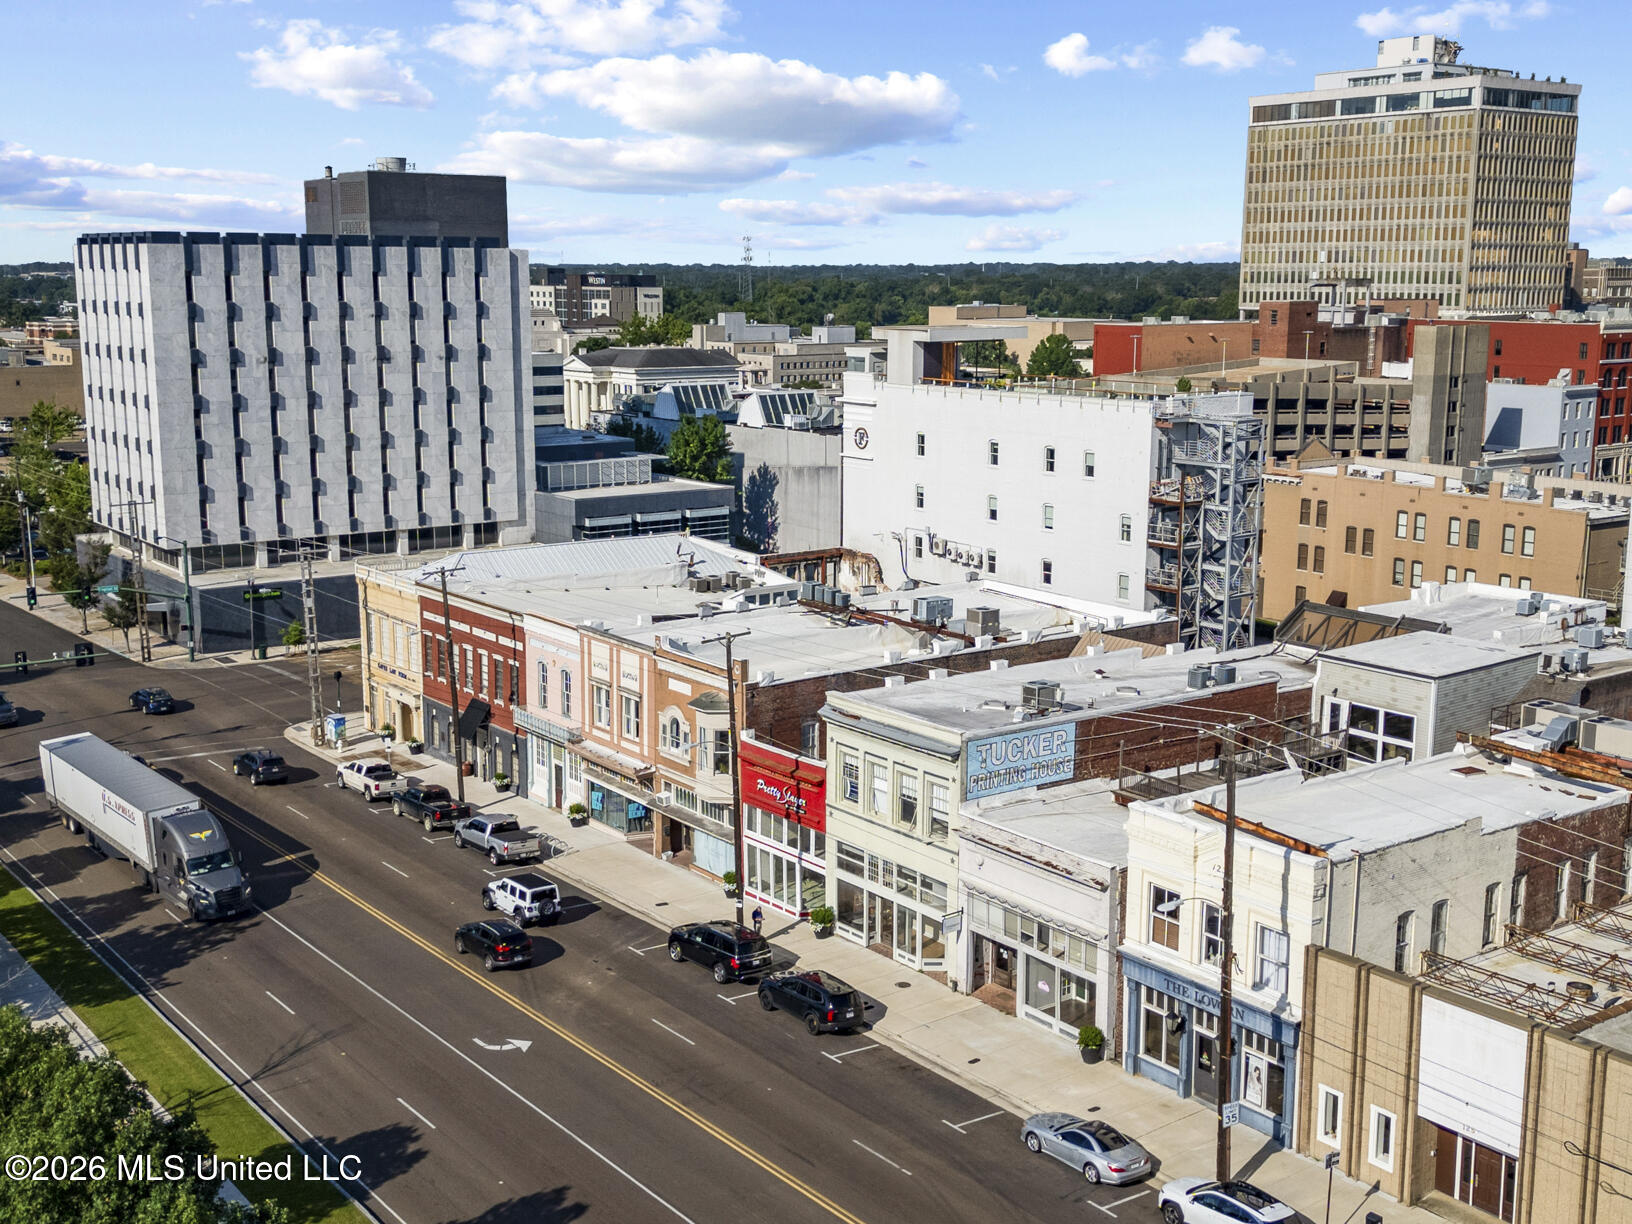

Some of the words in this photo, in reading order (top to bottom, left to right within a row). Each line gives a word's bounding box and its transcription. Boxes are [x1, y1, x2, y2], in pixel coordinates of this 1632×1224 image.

[976, 730, 1067, 769] TUCKER
[968, 766, 1027, 794] PRINTING
[1030, 756, 1073, 780] HOUSE
[757, 779, 782, 801] Pretty
[1164, 978, 1190, 999] THE
[1225, 1113, 1237, 1124] 35
